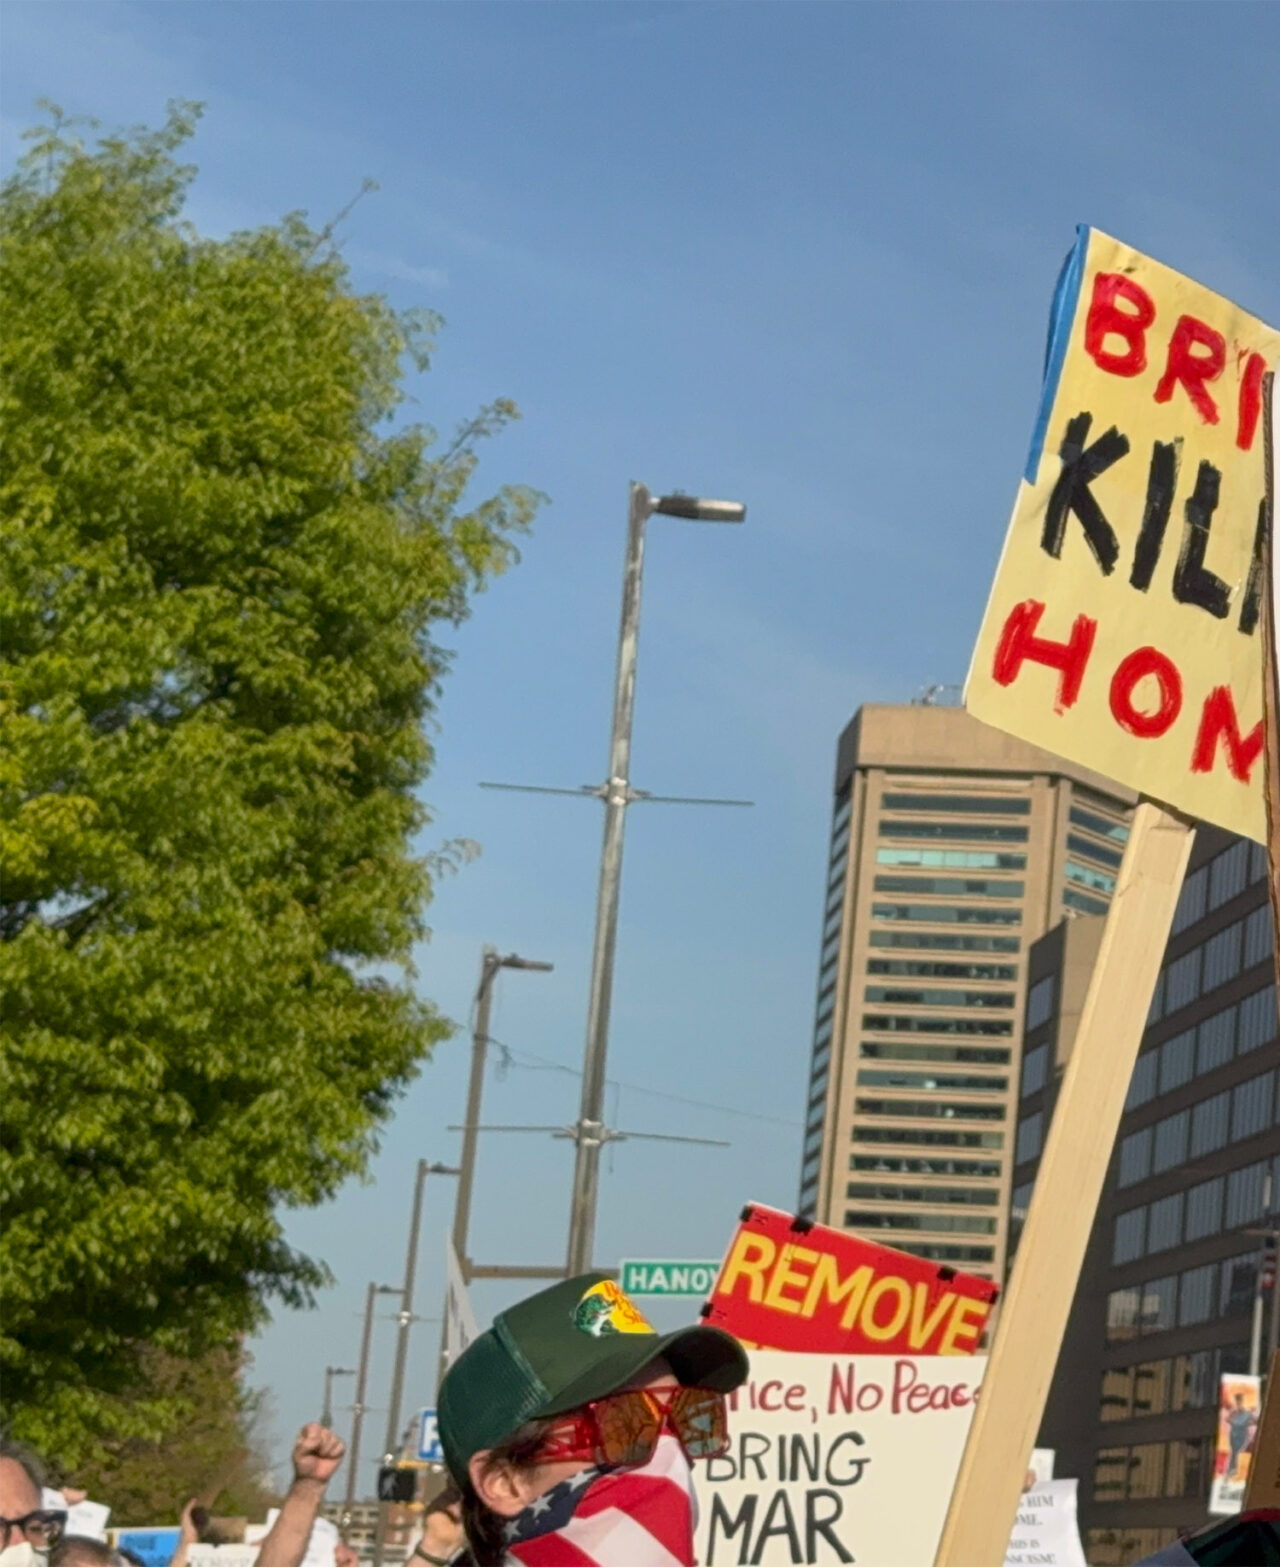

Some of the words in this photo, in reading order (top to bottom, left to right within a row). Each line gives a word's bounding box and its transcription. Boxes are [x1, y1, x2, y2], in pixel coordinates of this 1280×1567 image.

[1040, 411, 1266, 635] KIL
[719, 1230, 989, 1355] REMOVE
[827, 1362, 884, 1415] No
[891, 1360, 983, 1415] Peac
[706, 1489, 855, 1567] MAR
